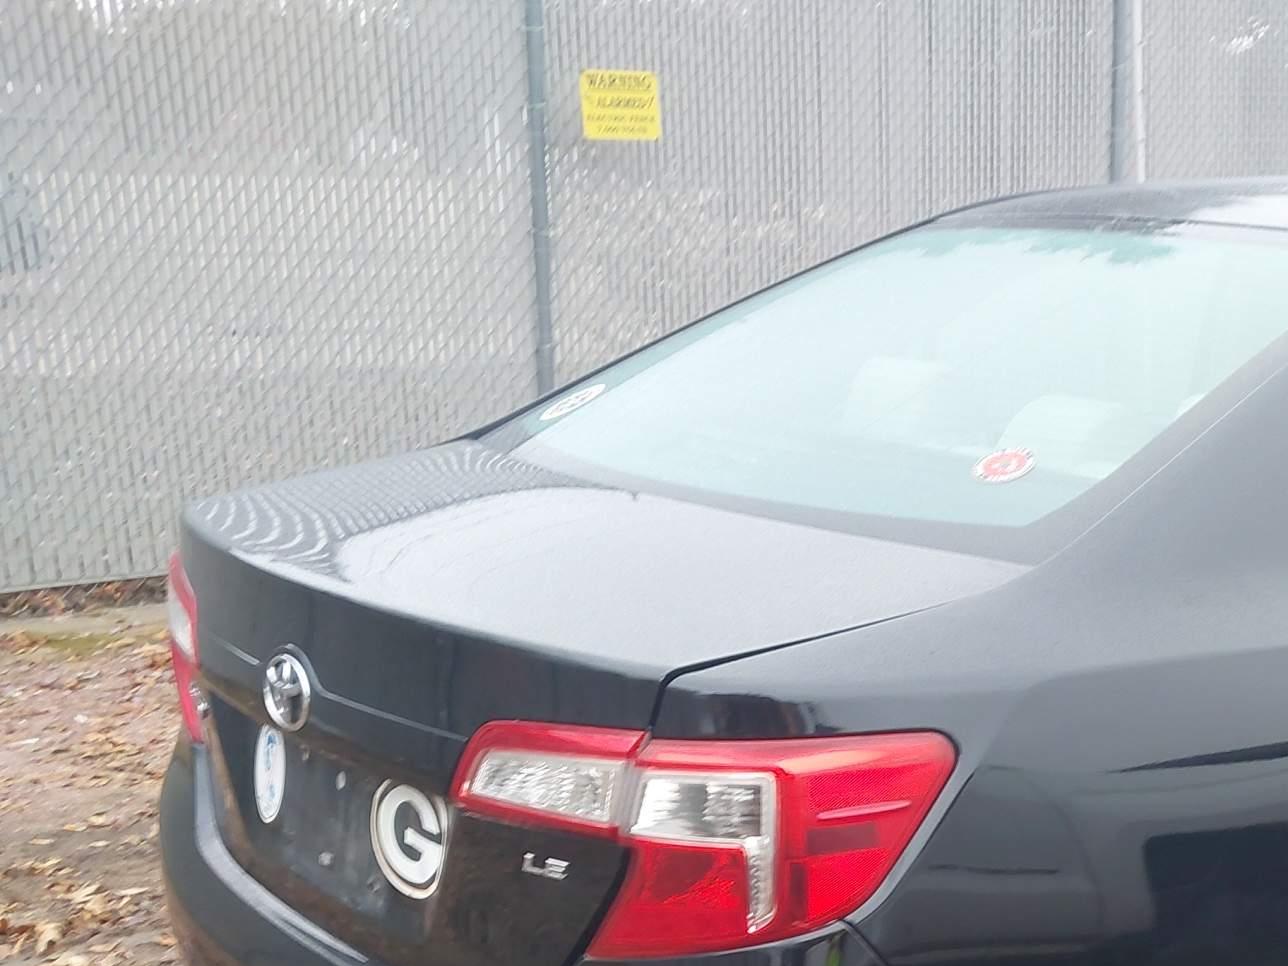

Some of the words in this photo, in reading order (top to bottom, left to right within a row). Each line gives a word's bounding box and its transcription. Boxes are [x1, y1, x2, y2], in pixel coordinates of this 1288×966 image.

[587, 73, 651, 90] WARNING
[377, 784, 442, 884] G
[521, 852, 570, 881] LE
